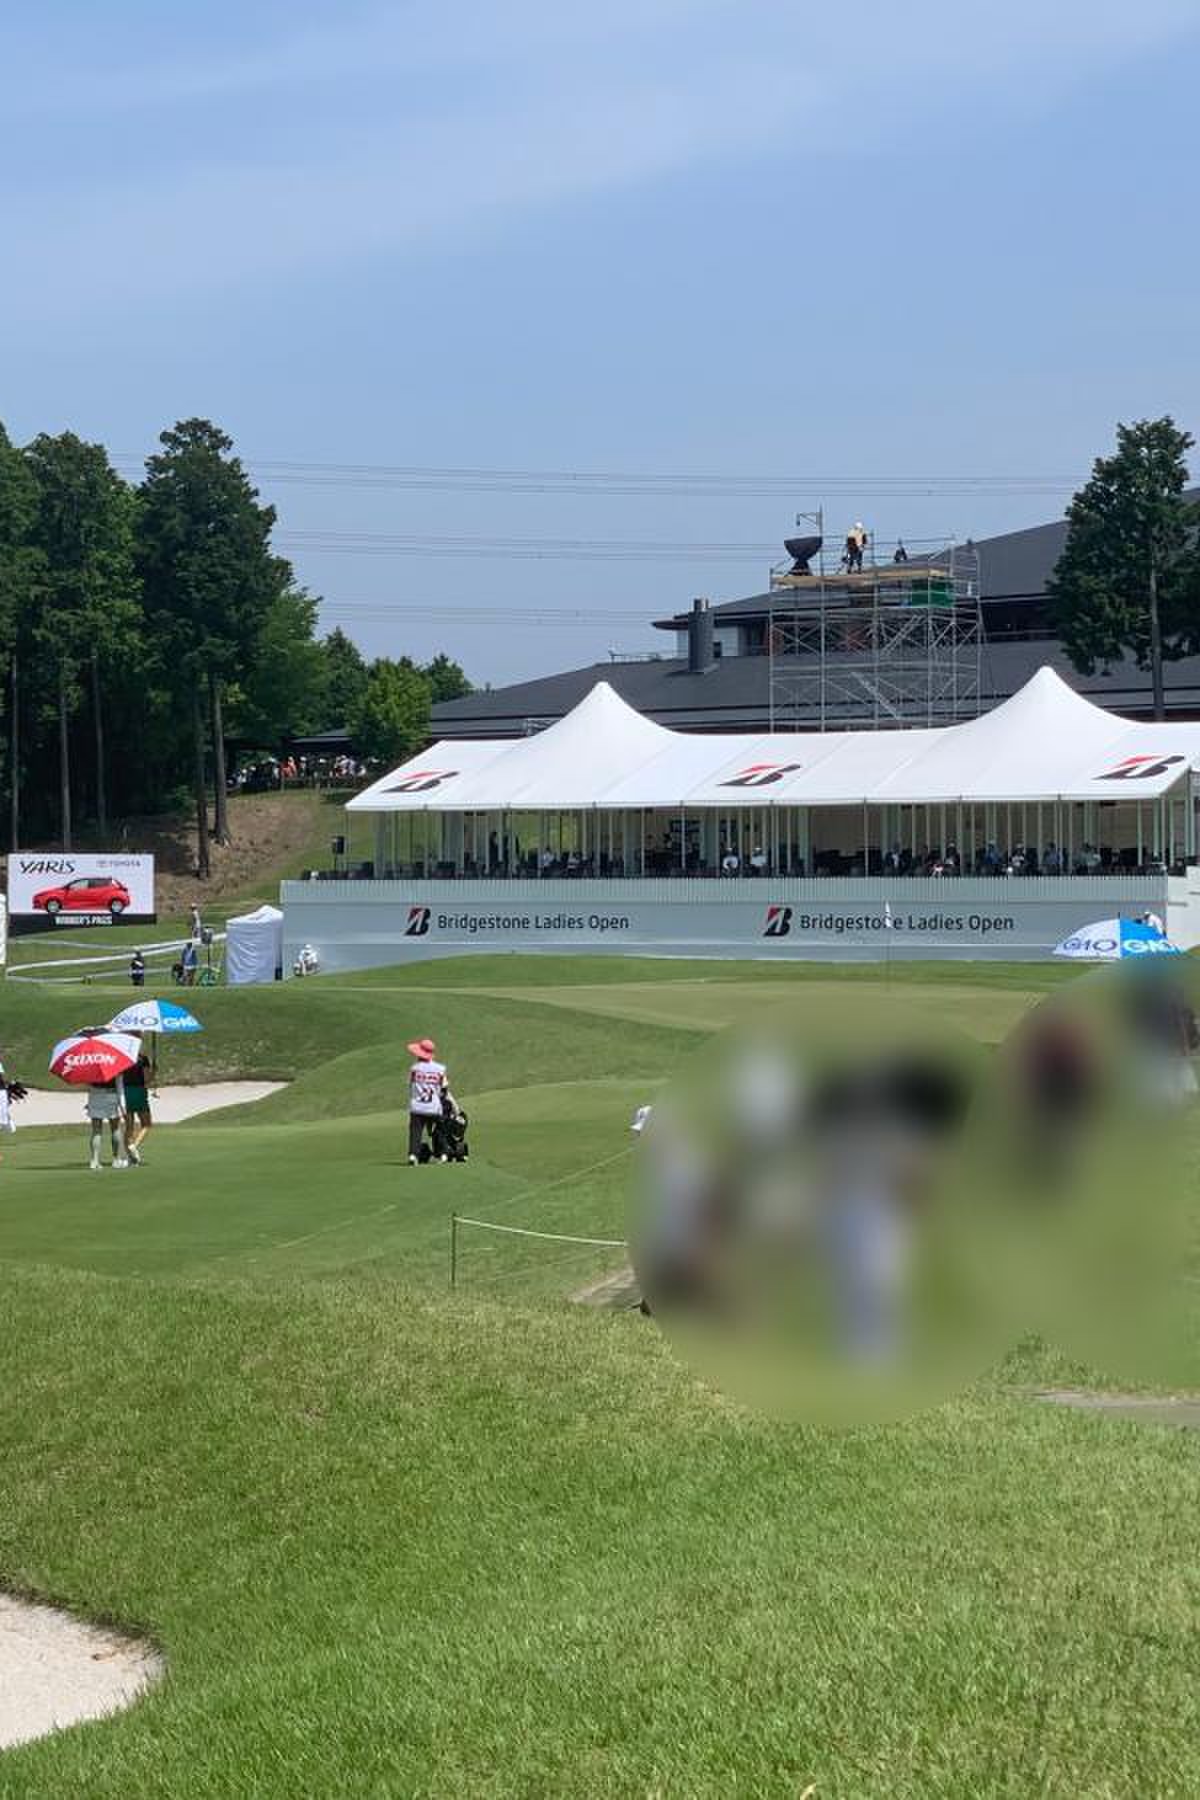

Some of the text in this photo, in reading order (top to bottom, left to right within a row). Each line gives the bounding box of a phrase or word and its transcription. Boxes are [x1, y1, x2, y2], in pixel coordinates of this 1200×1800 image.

[437, 913, 629, 933] Bridgestone Ladies Open
[800, 913, 1015, 934] Bridgestoe Ladies Open
